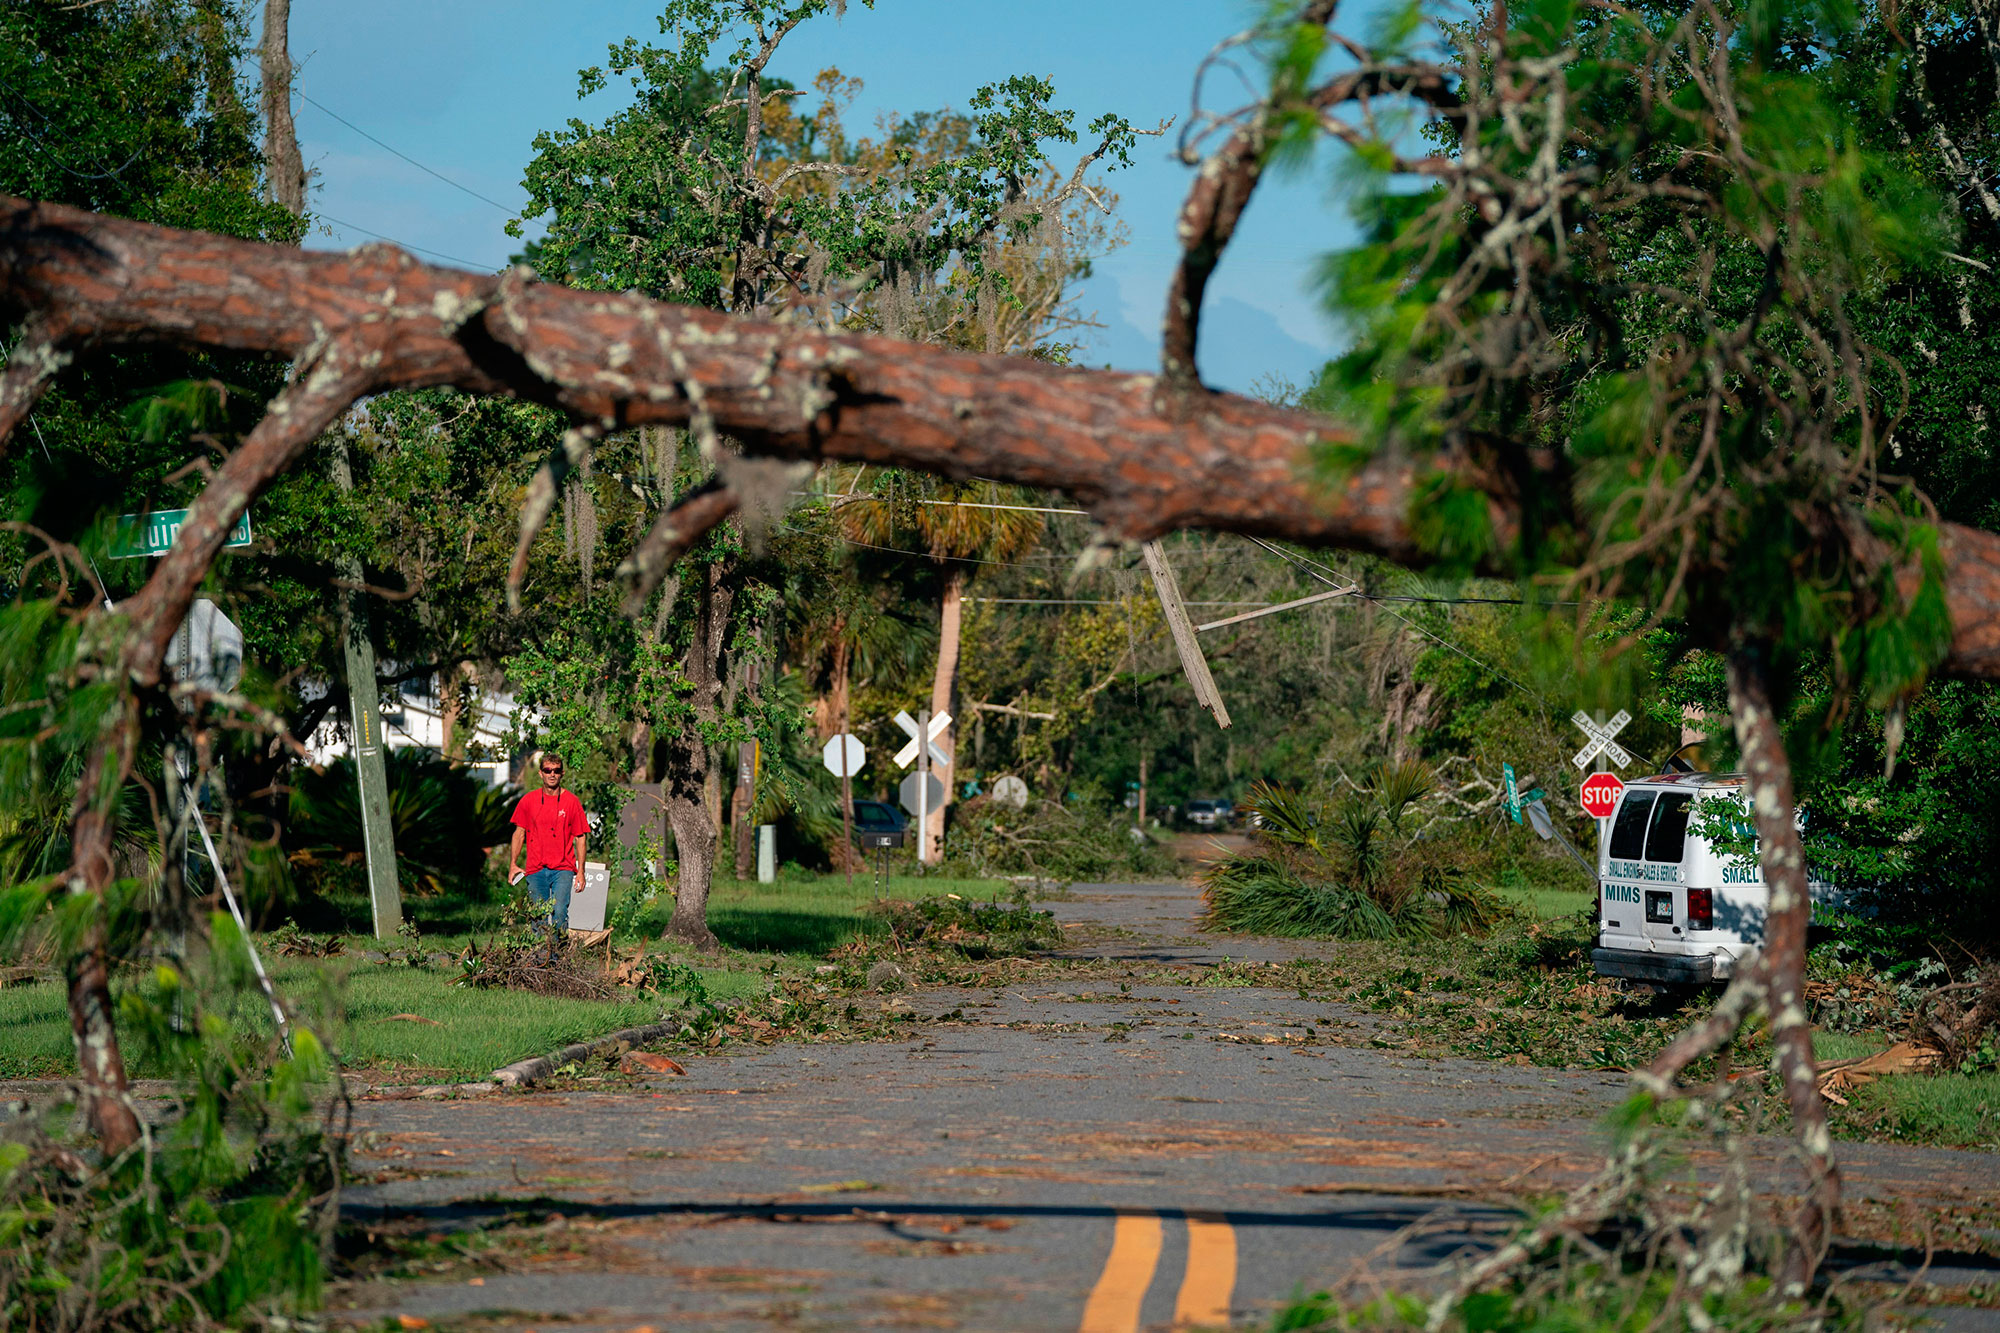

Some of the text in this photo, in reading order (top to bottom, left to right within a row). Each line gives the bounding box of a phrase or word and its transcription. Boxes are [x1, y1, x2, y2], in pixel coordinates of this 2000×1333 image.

[1584, 787, 1622, 804] STOP
[1609, 861, 1623, 878] SMALL
[1643, 864, 1656, 880] SALES
[1656, 865, 1660, 881] &
[1660, 865, 1678, 882] SERVICE
[1722, 867, 1759, 884] SMALL
[1605, 884, 1641, 904] MIMS
